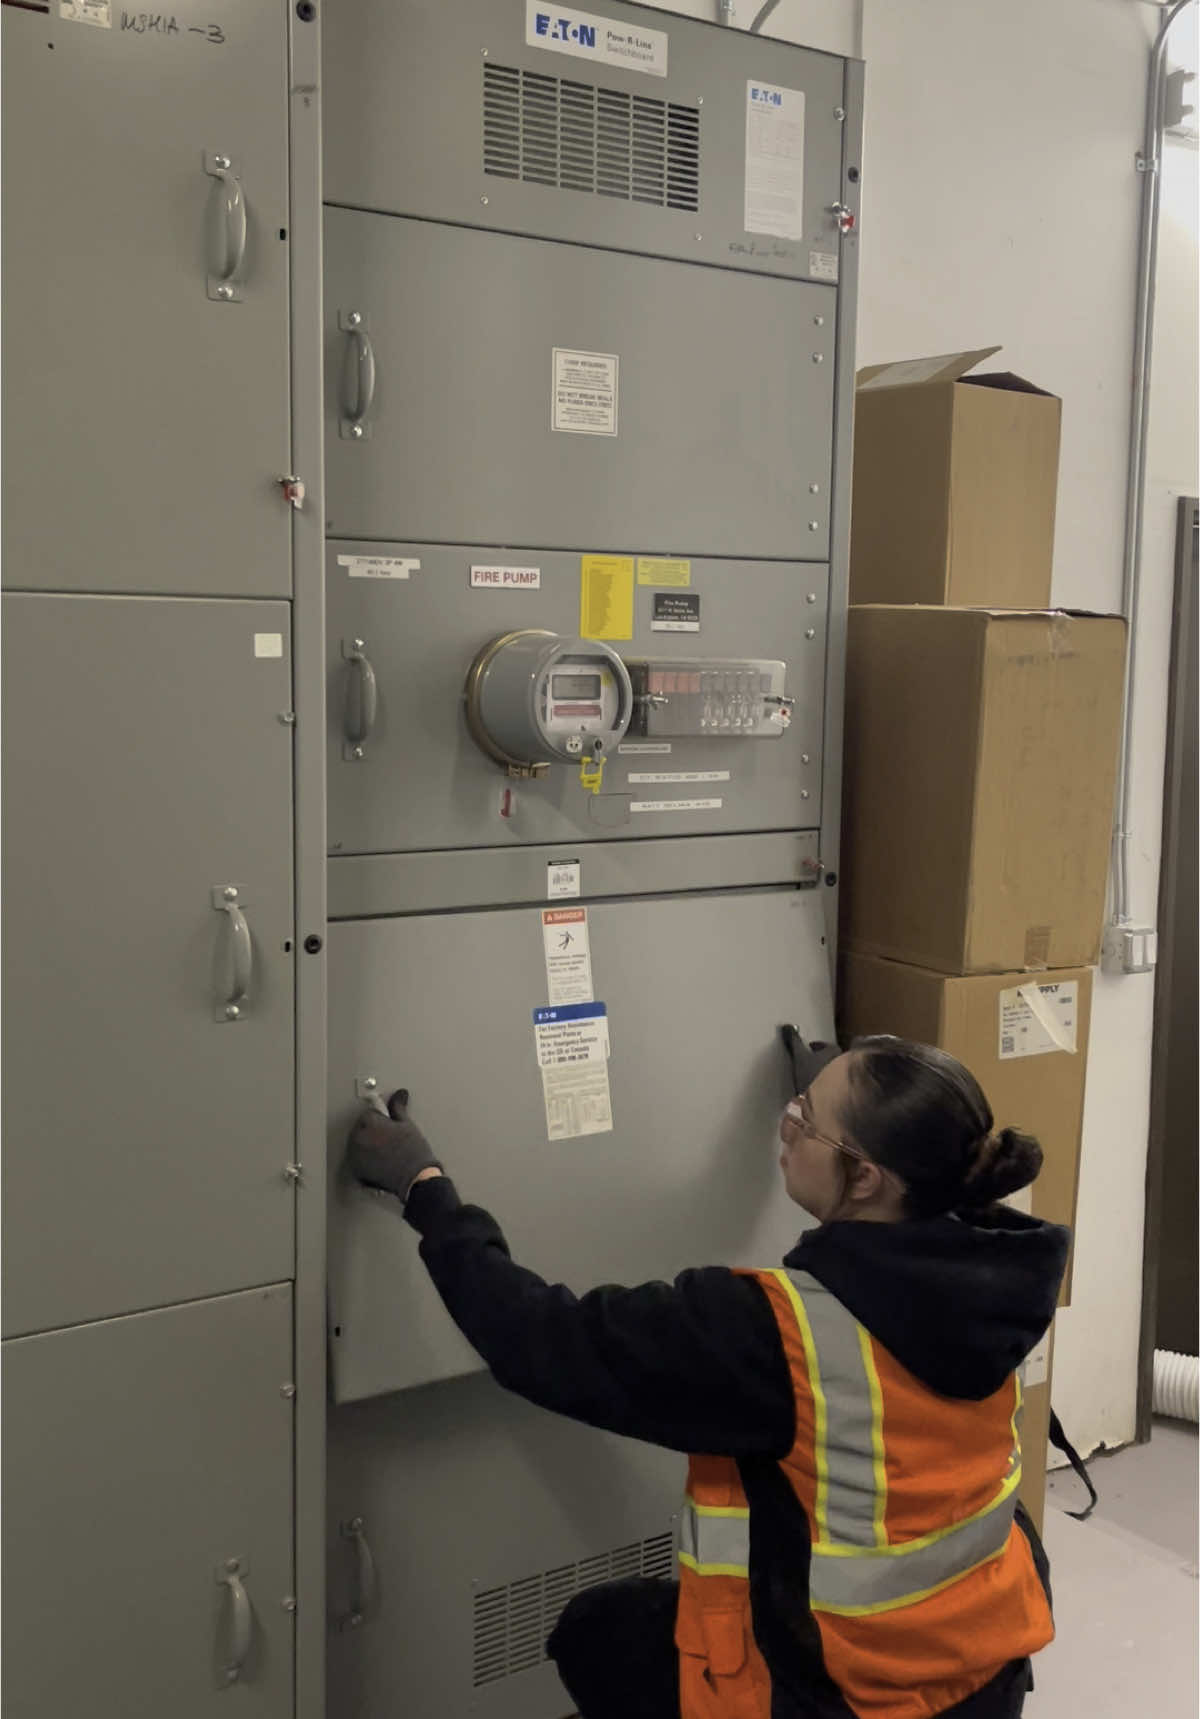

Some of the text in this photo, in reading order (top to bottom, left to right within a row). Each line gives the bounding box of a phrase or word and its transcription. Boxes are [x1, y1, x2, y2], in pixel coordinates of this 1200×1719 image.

[535, 12, 596, 48] EATON
[751, 87, 782, 106] EATON
[474, 570, 538, 585] FIRE PUMP
[552, 910, 584, 922] DANGER
